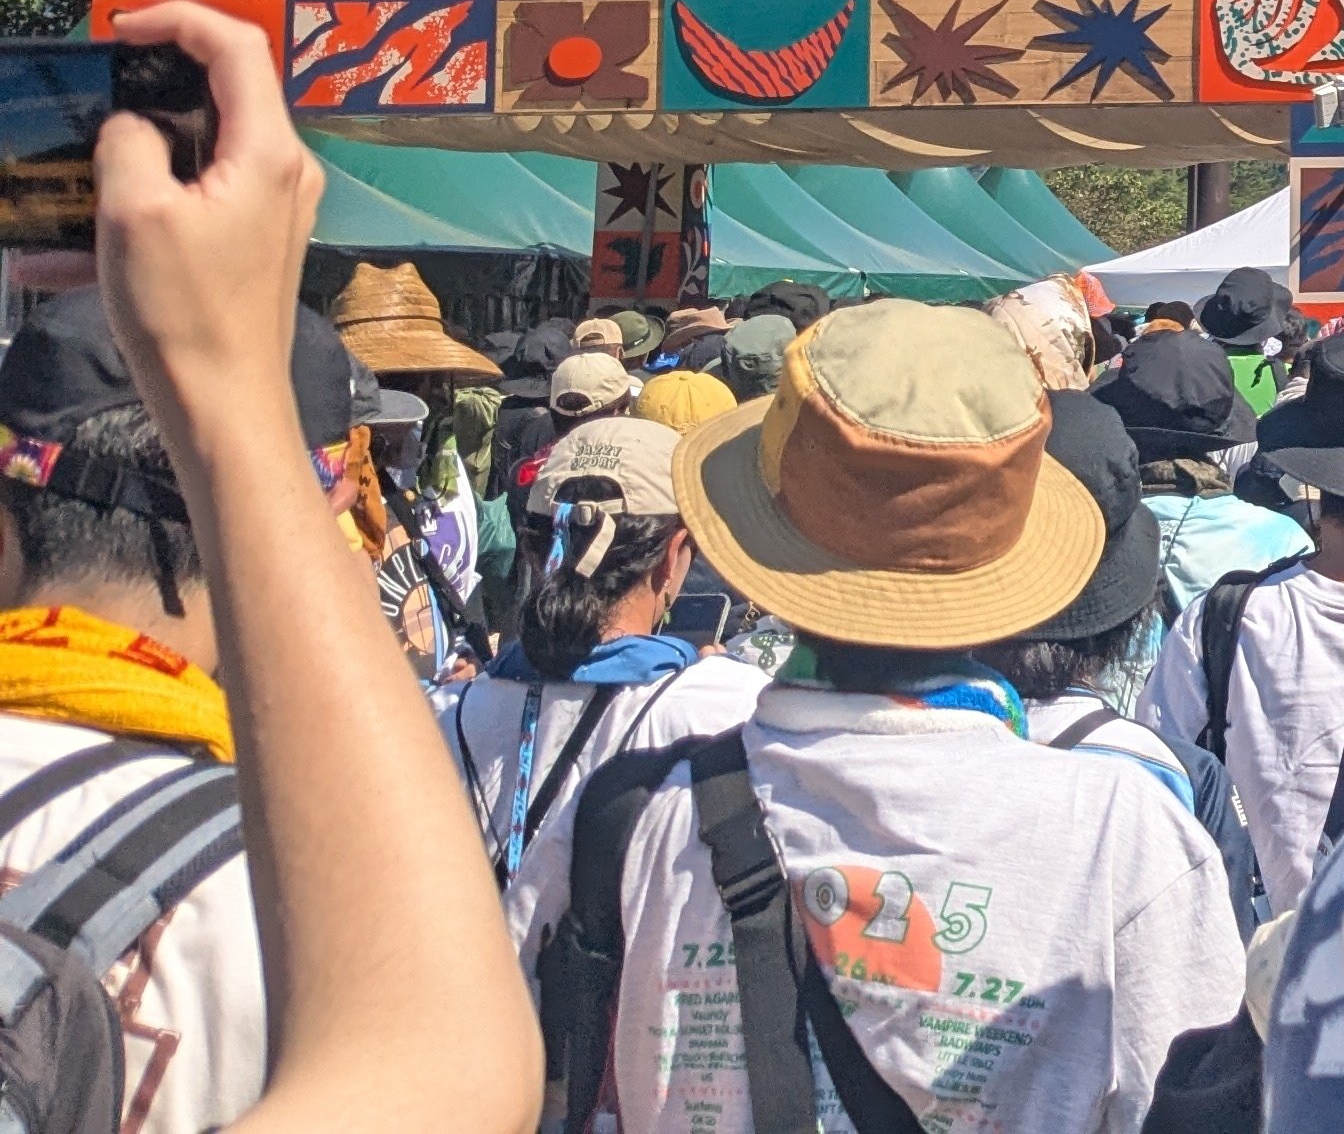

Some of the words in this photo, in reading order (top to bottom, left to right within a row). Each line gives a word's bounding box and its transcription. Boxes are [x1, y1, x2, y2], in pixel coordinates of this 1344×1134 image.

[576, 444, 622, 457] JAZZY
[570, 456, 621, 471] SPORT
[953, 971, 1025, 1003] 7.27
[919, 1015, 973, 1036] VAMPIRE
[975, 1023, 1034, 1046] WEEKEND
